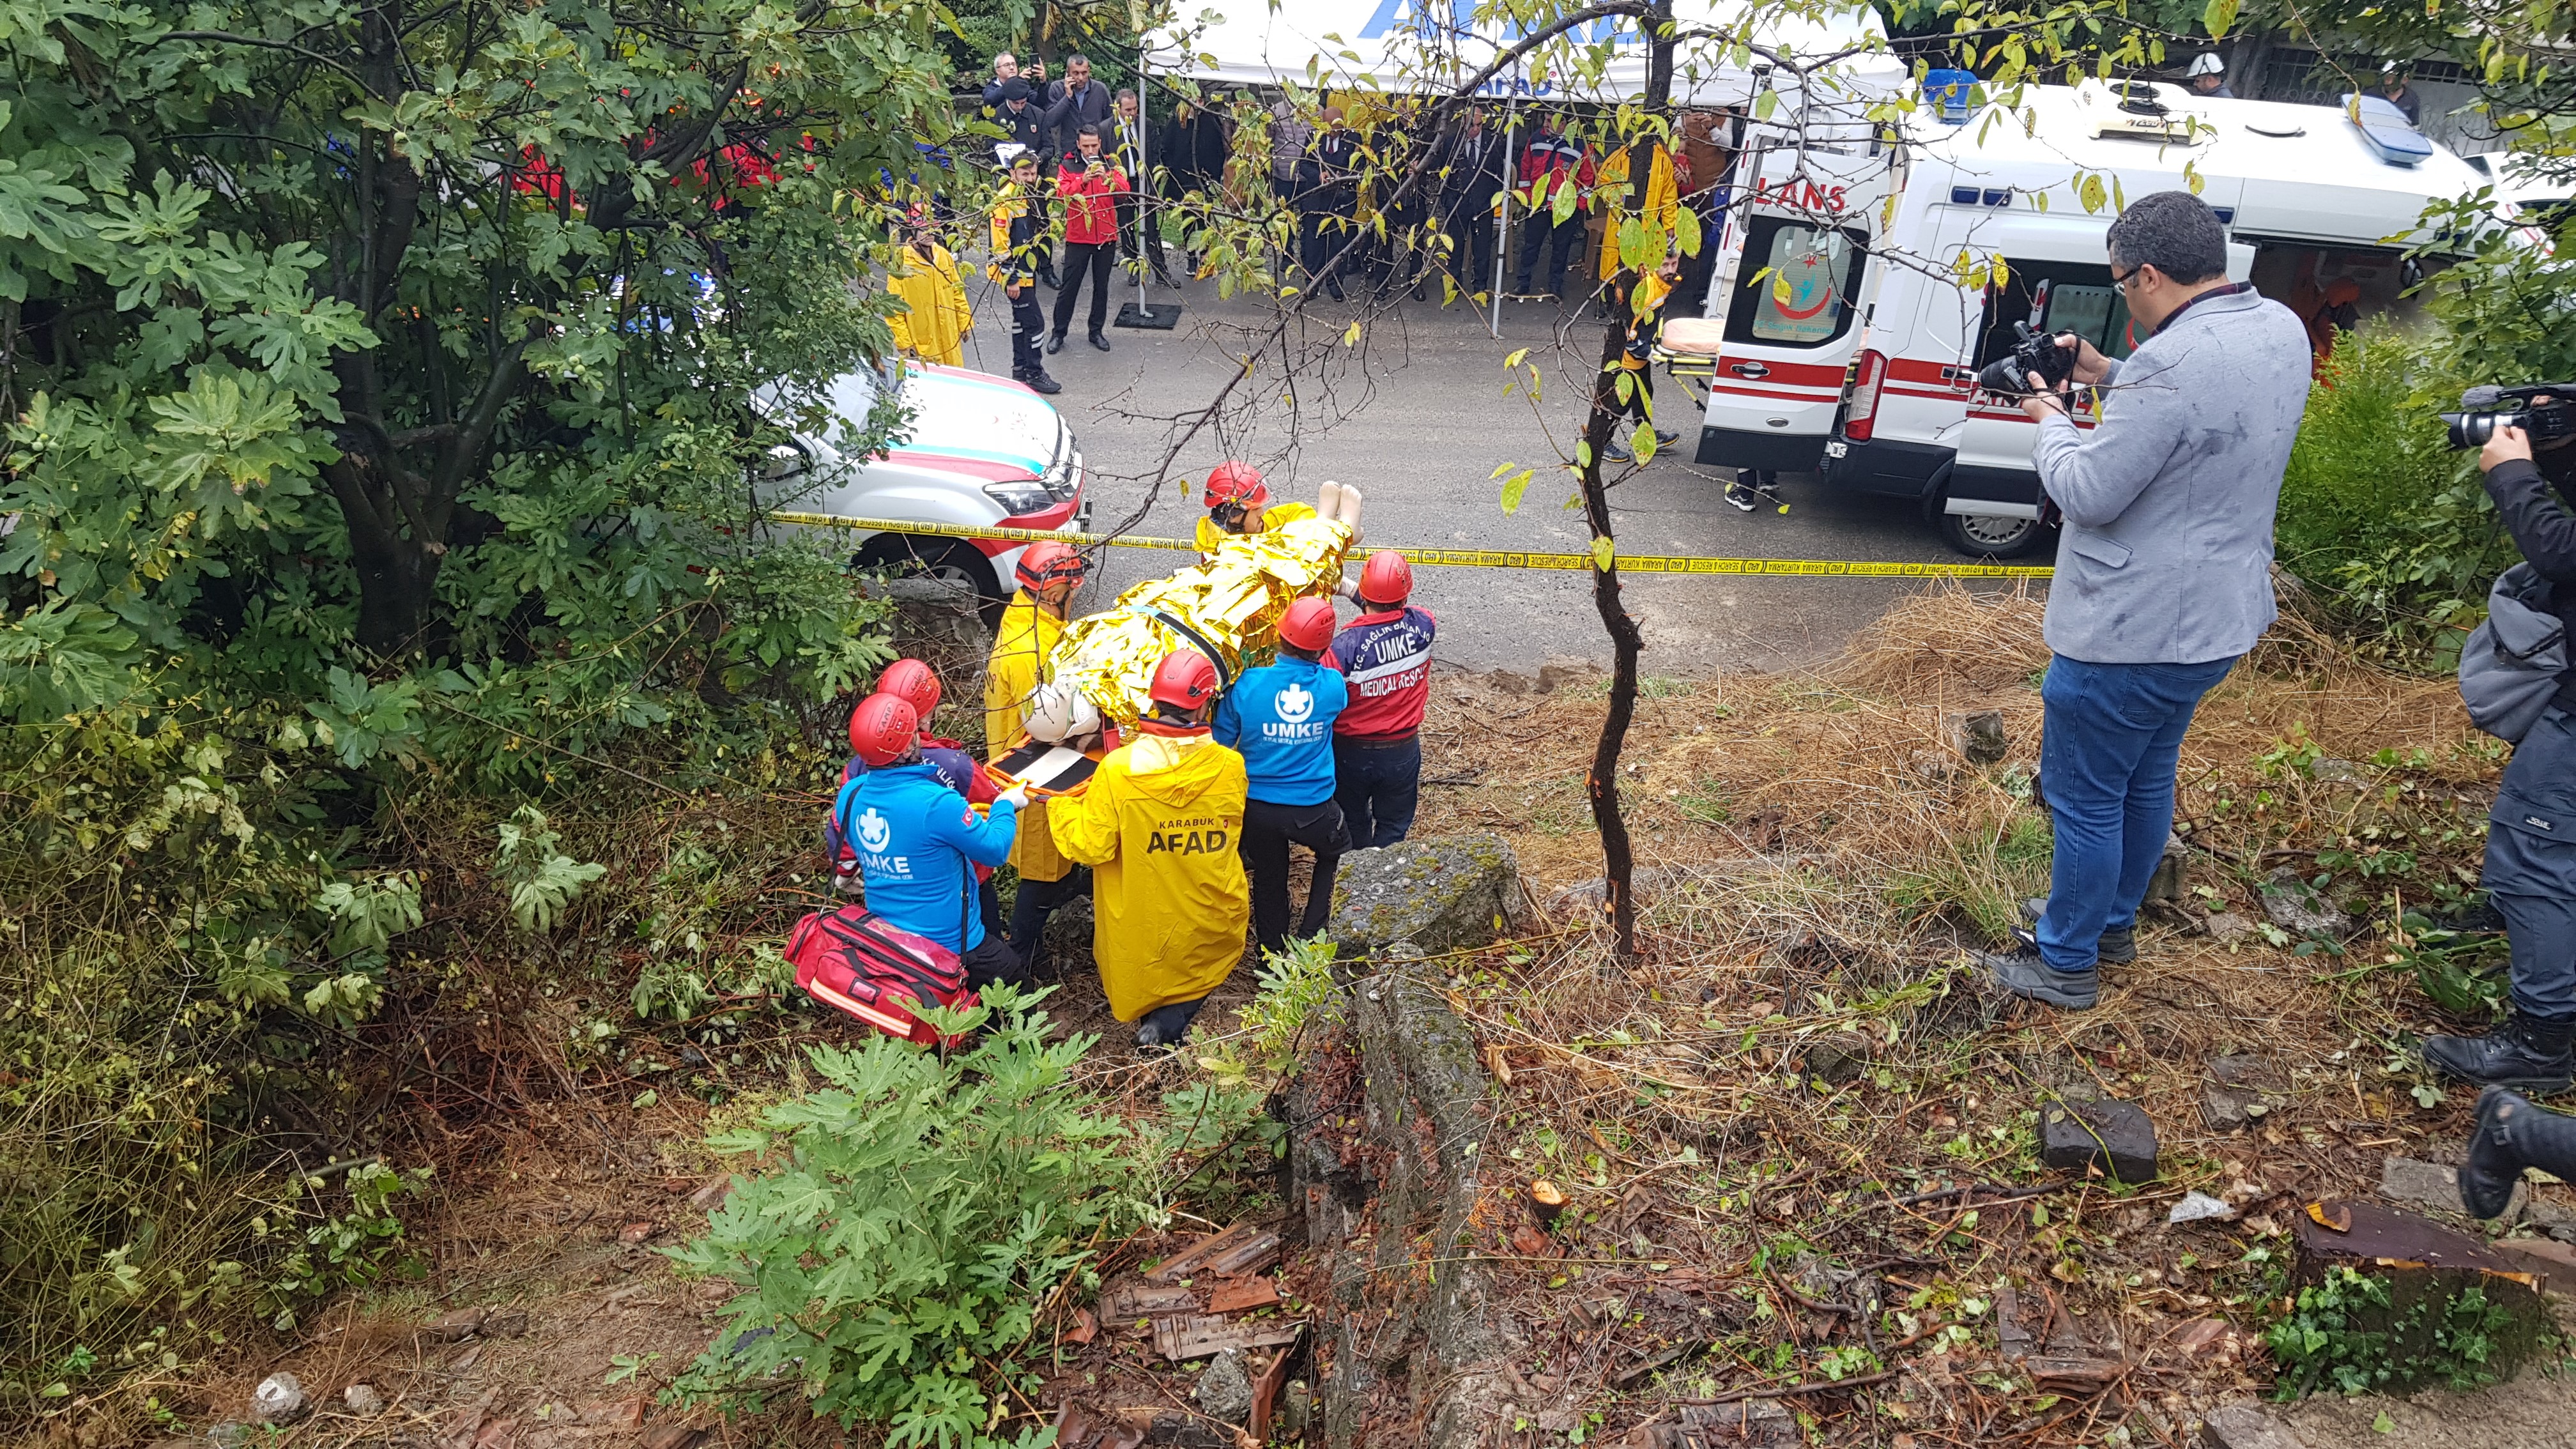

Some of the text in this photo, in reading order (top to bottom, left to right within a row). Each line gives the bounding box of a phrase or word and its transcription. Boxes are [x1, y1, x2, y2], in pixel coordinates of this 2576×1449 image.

[944, 525, 1002, 537] KURTARMA ARAMA
[1011, 529, 1023, 537] AFAD
[1034, 531, 1055, 539] RESCUE
[1115, 536, 1172, 548] KURTARMA ARAMA
[1181, 540, 1193, 549] AFAD
[1425, 553, 1437, 561] AFAD
[1446, 553, 1501, 564] KURTARMA ARAMA
[1509, 555, 1521, 565] AFAD
[1531, 556, 1551, 566] RESCUE
[1557, 558, 1578, 567] SEARCH
[1642, 560, 1663, 570] ARAMA
[1671, 561, 1683, 570] AFAD
[1692, 561, 1739, 572] RESCUE & SEARCH
[1747, 562, 1759, 571] AFAD
[1768, 563, 1823, 572] KURTARMA ARAMA
[1830, 564, 1843, 572] AFAD
[1878, 565, 1899, 573] SEARCH
[1374, 632, 1417, 664] UMKE
[1360, 677, 1397, 697] MEDICAL
[878, 706, 892, 733] CAMP
[1262, 721, 1324, 739] UMKE
[1159, 816, 1215, 829] KARABÜK
[1146, 831, 1227, 856] AFAD
